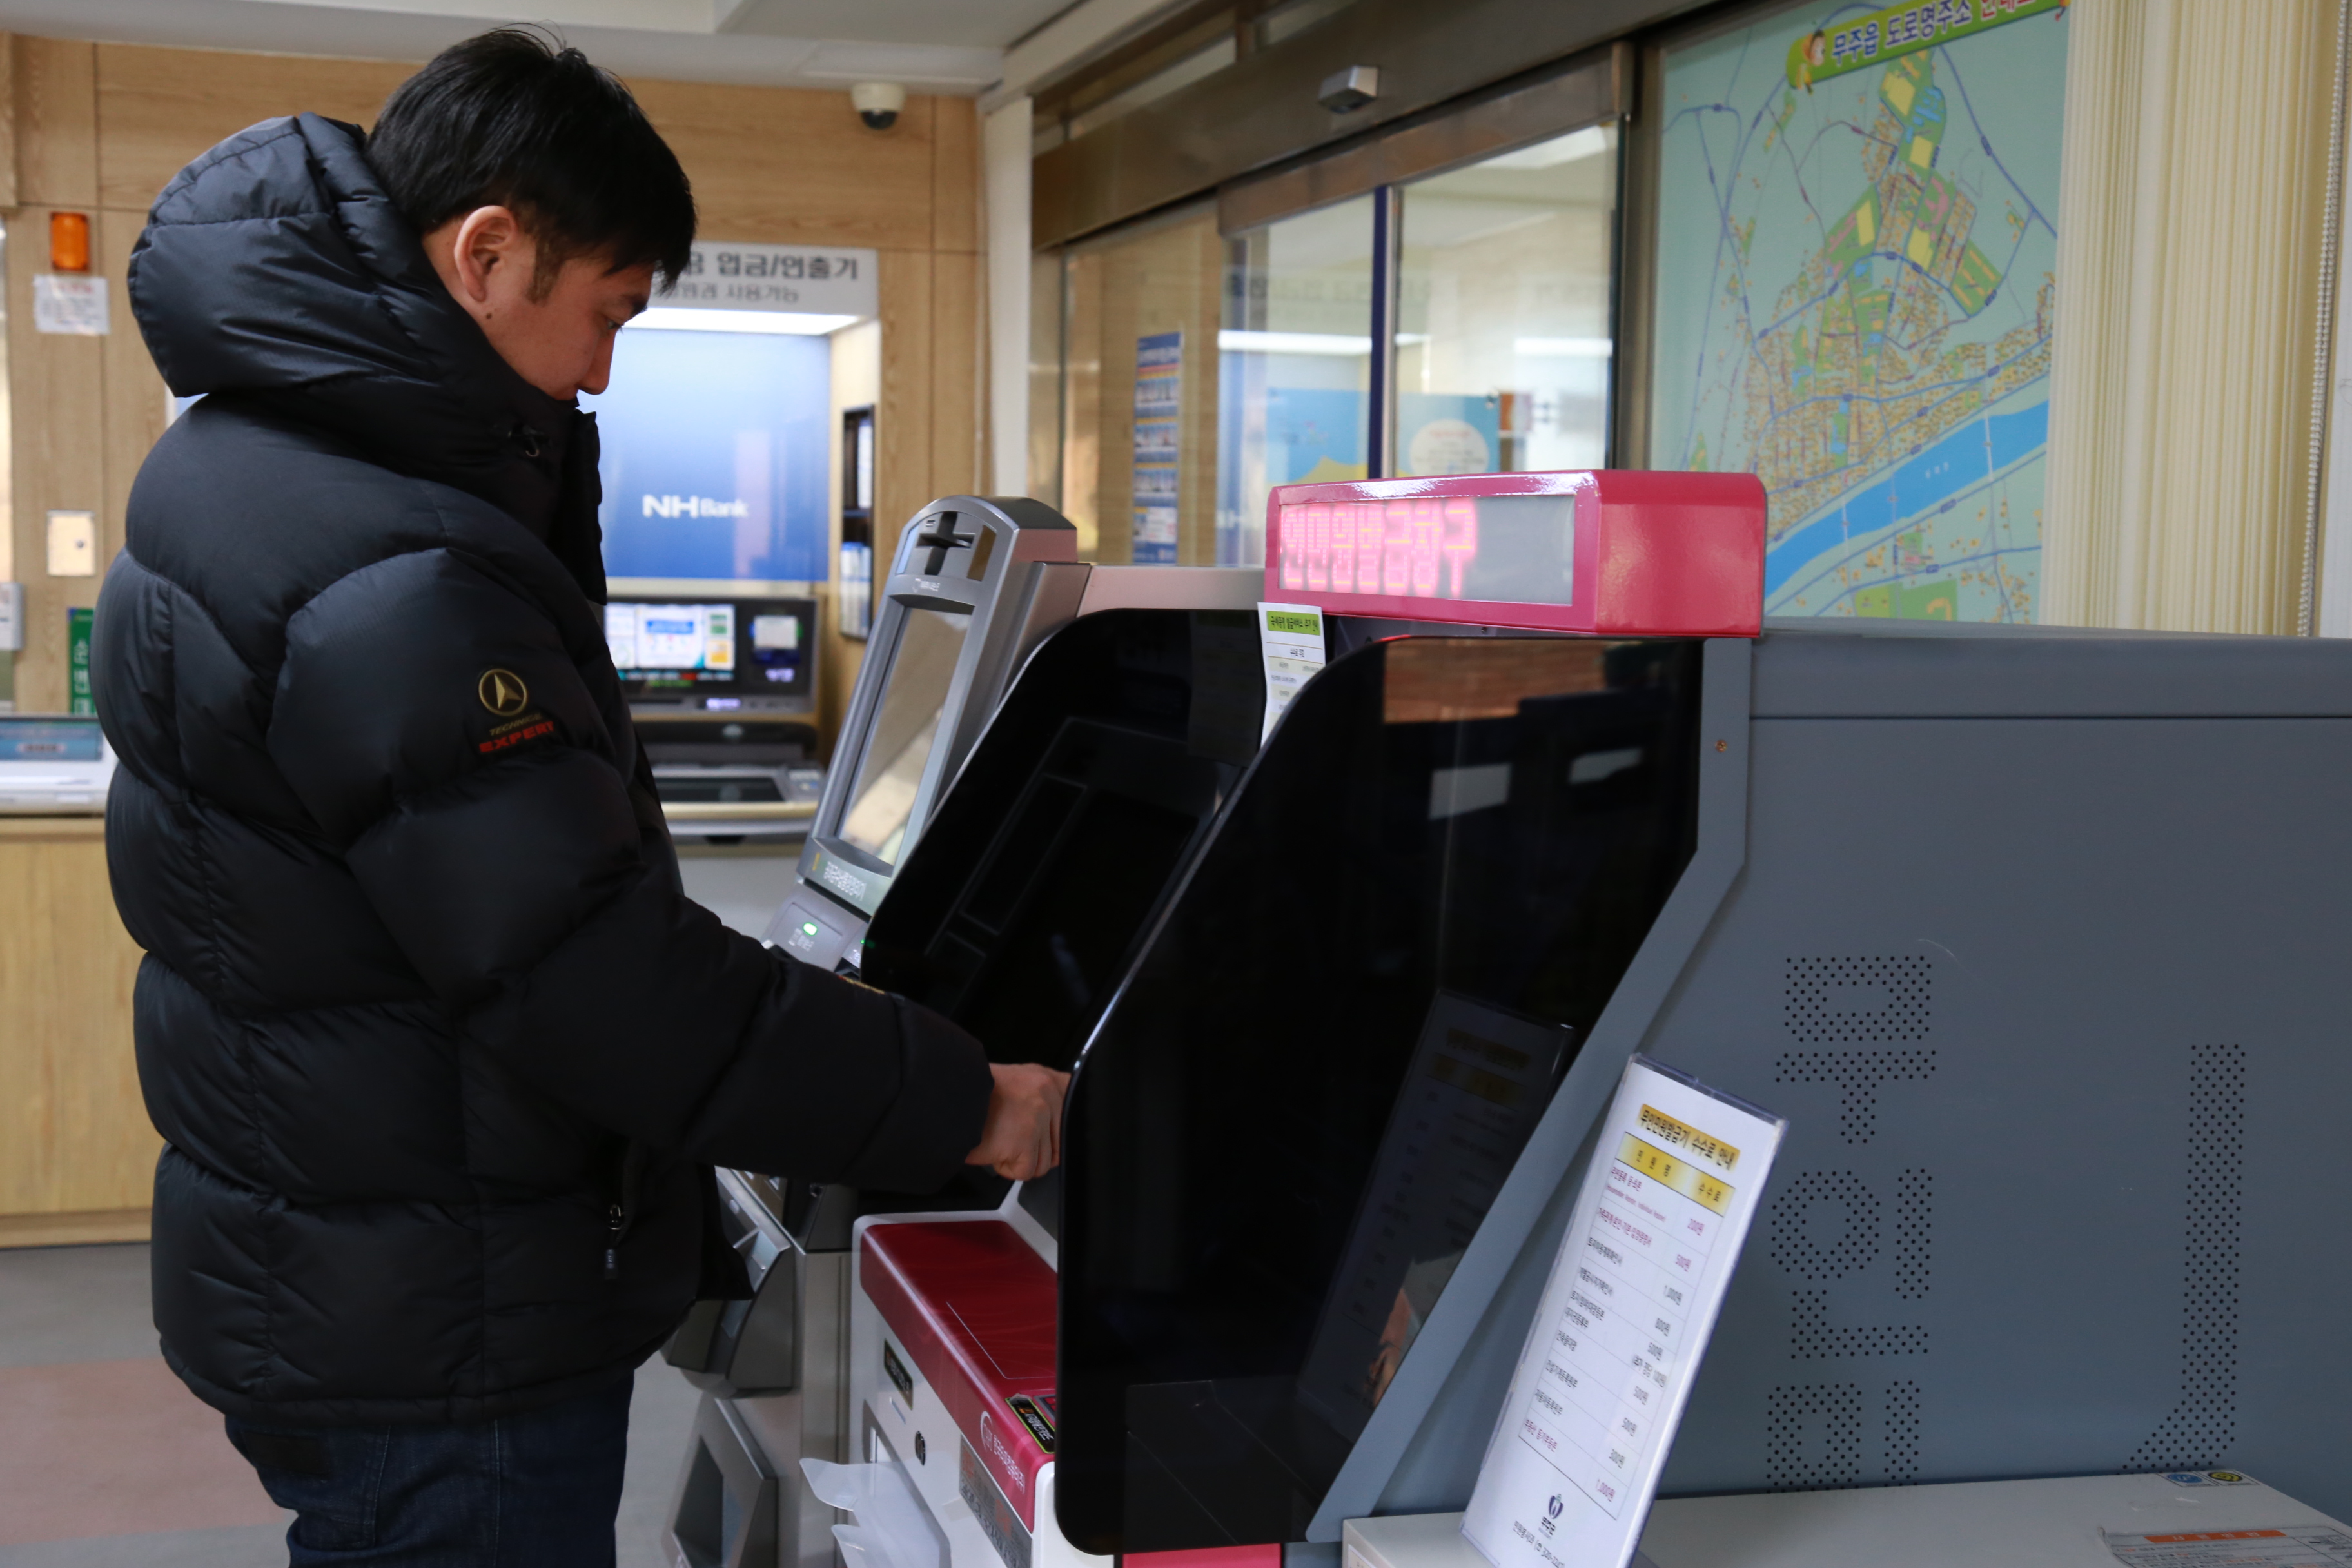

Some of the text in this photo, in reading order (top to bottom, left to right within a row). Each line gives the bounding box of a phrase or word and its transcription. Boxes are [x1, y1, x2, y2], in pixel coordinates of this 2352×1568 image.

[1832, 21, 1879, 64] 무주읍
[1885, 0, 1972, 48] 도로명주소
[479, 721, 554, 753] EXPERT
[1692, 1135, 1716, 1159] 수수료
[1717, 1148, 1736, 1171] 안내
